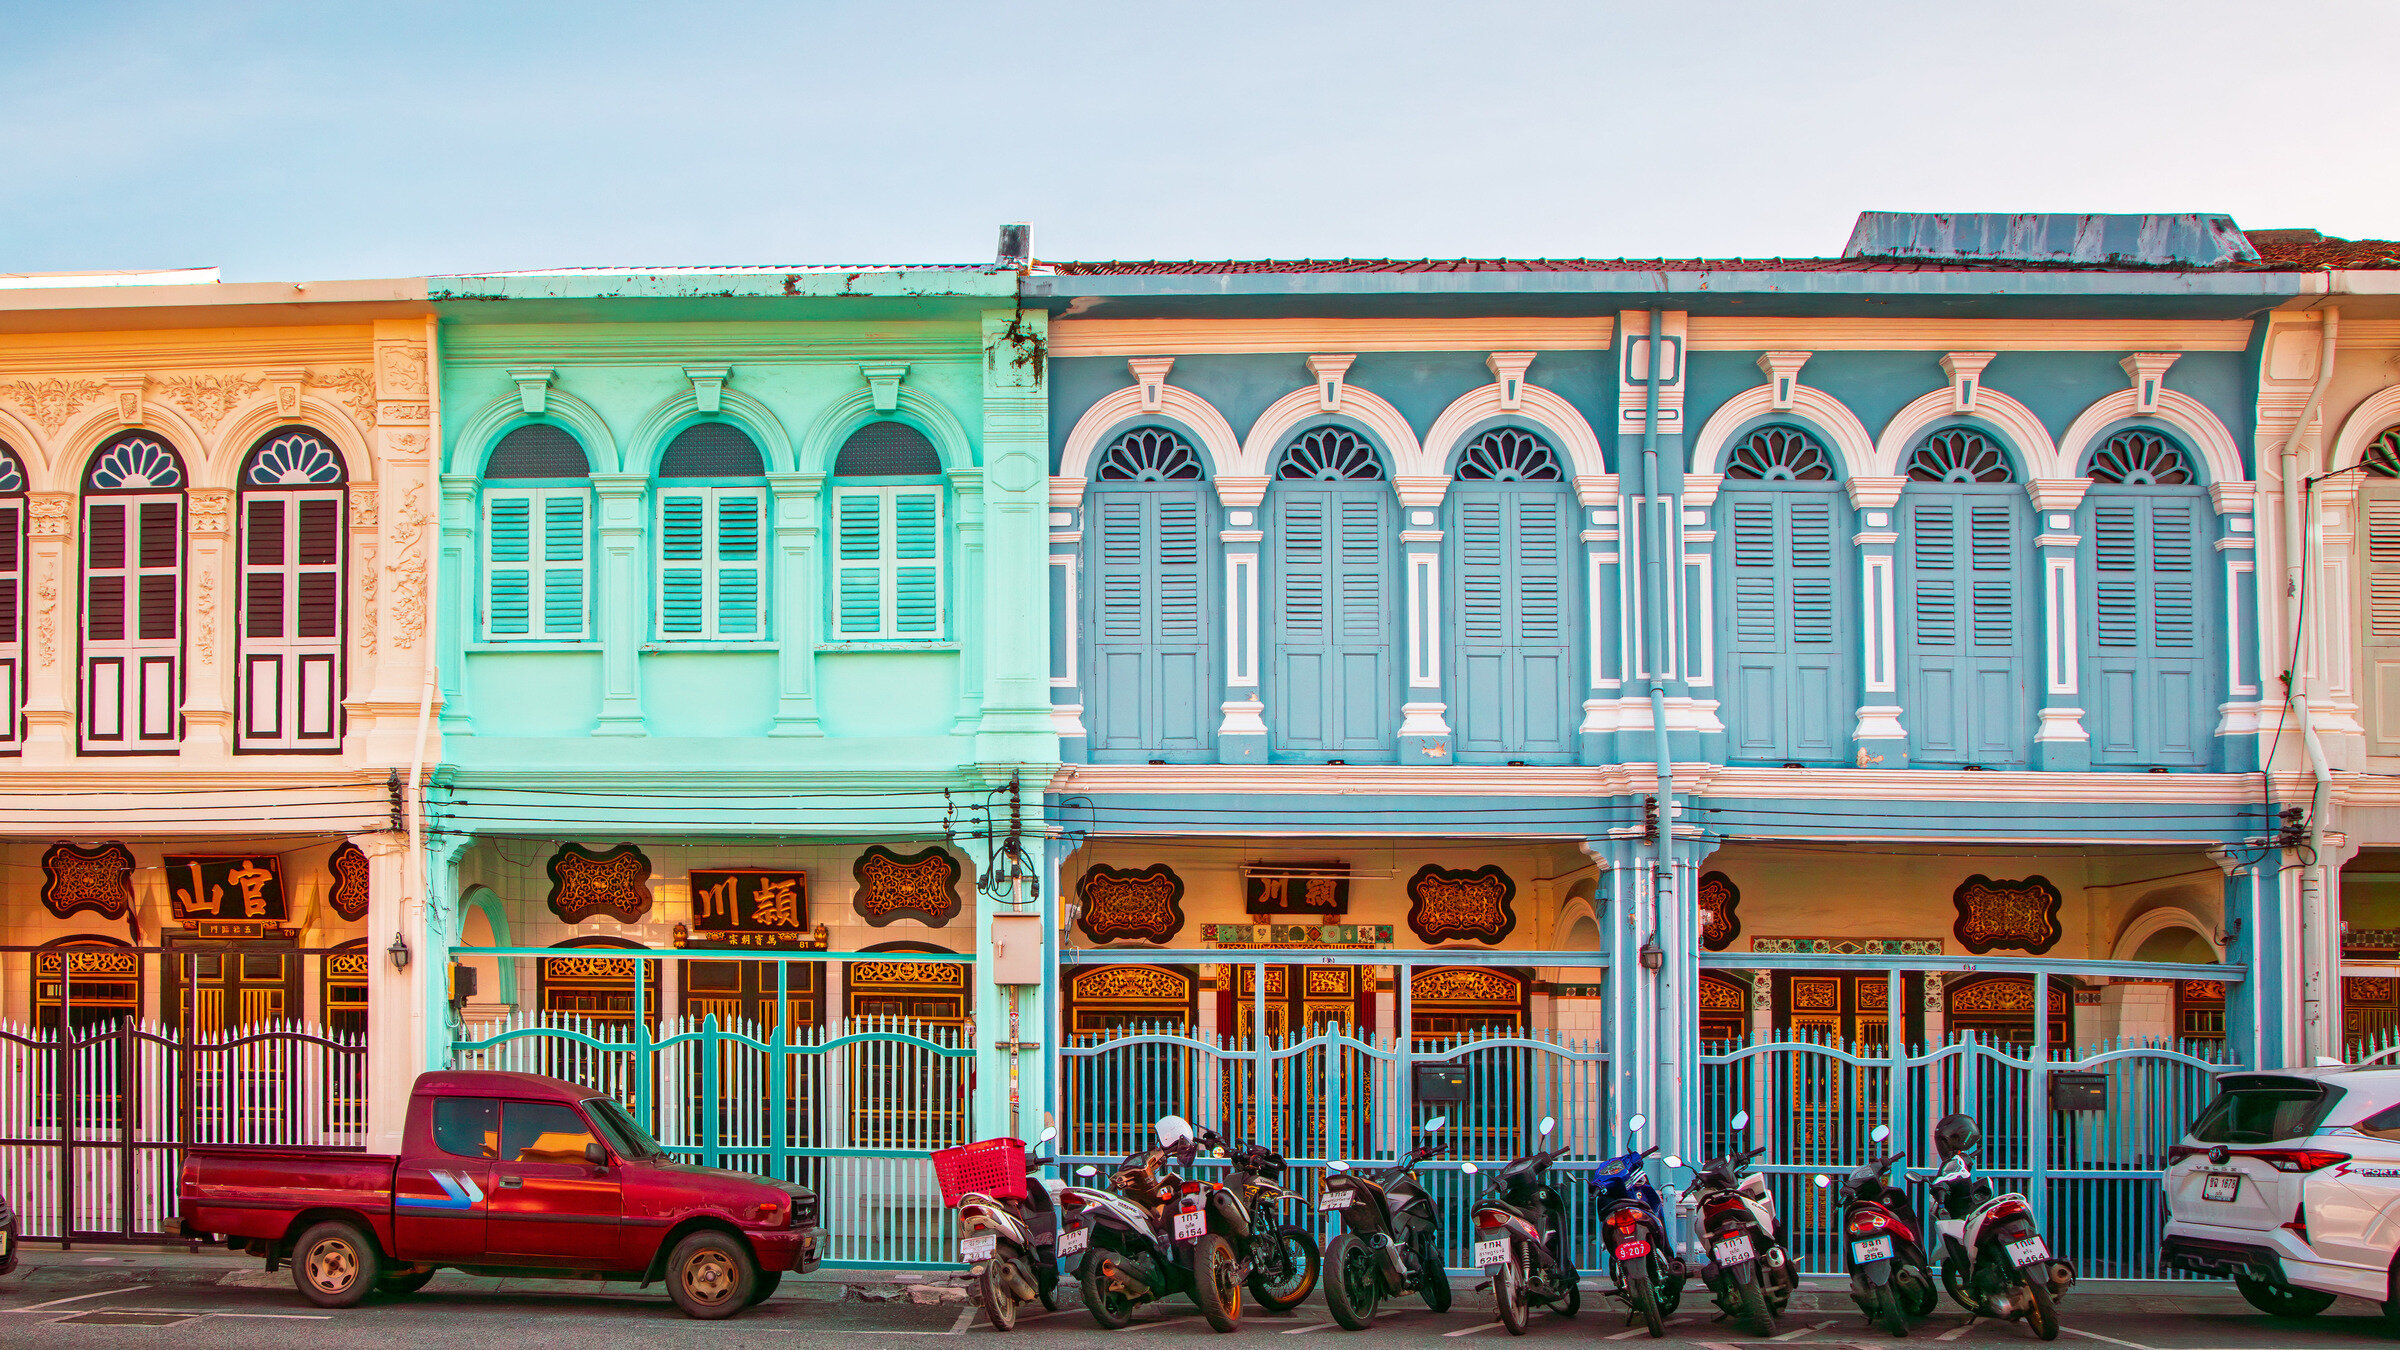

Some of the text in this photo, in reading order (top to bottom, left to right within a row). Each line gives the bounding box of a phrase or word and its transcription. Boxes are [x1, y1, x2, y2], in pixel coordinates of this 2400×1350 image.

[283, 929, 295, 937] 79
[799, 941, 809, 949] 81
[1178, 1227, 1202, 1239] 6154
[1479, 1254, 1505, 1265] 6285
[1724, 1251, 1750, 1264] 5649
[1863, 1251, 1884, 1261] 255
[2017, 1252, 2045, 1266] 8464
